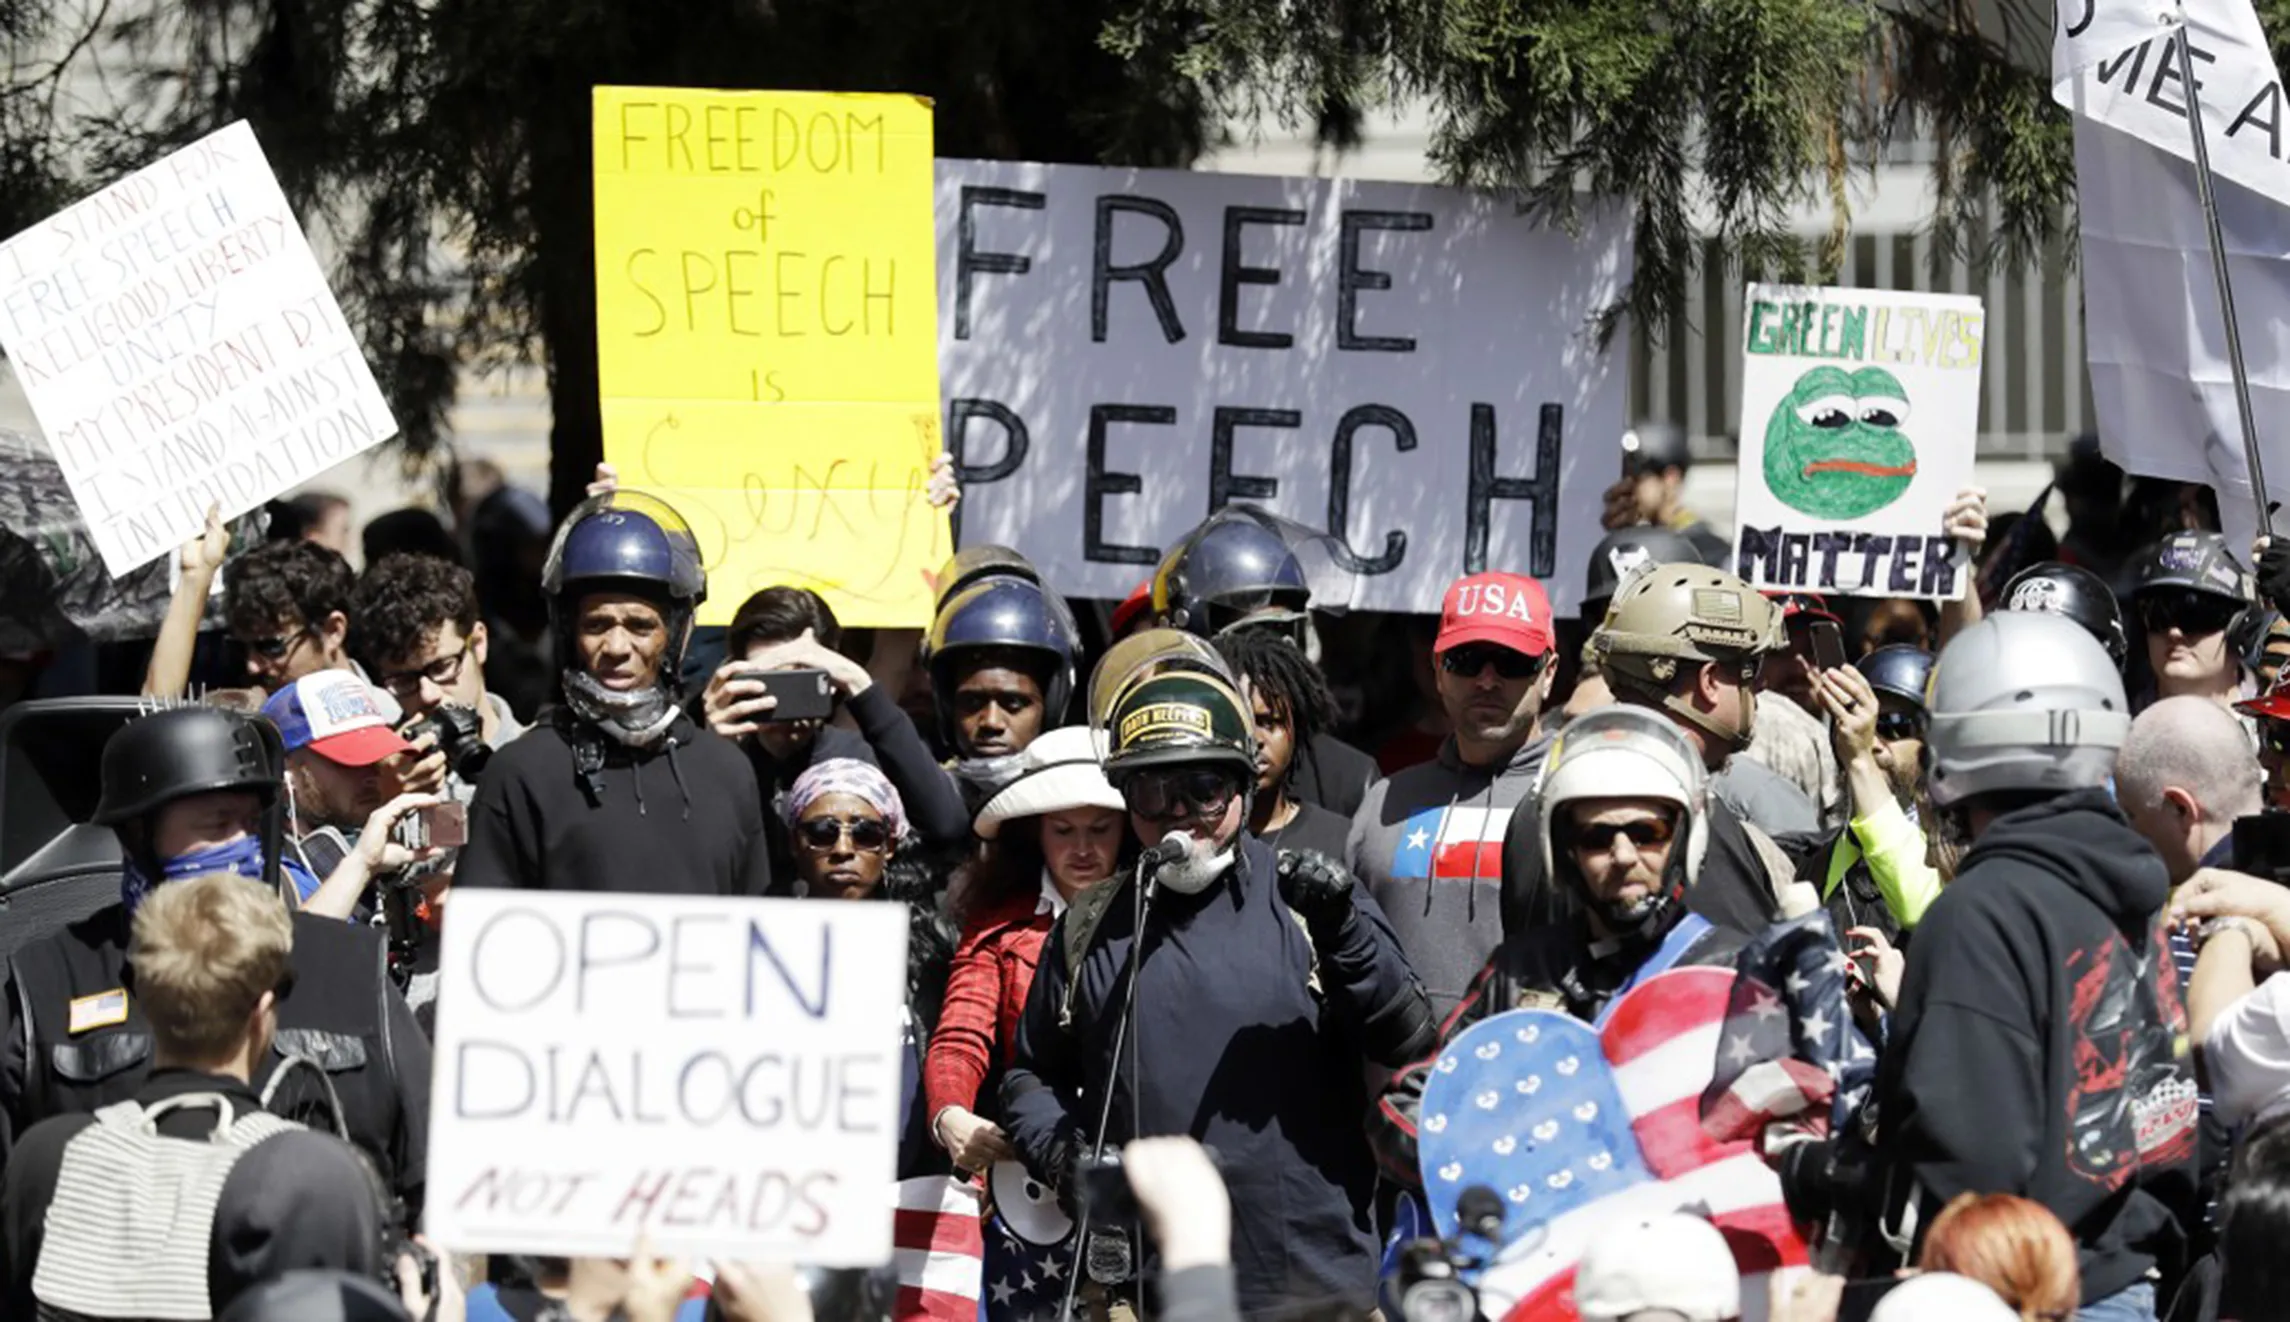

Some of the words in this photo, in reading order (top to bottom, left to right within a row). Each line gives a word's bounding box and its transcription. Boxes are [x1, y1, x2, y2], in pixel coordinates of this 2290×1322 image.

[621, 102, 885, 174] FREEDOM
[2224, 80, 2290, 165] A
[7, 236, 37, 284] I
[50, 176, 158, 257] STAND
[169, 136, 239, 191] FOR
[732, 189, 778, 243] of
[2, 259, 100, 336] FREE
[101, 186, 237, 285] SPEECH
[15, 276, 170, 387] RELIGIOUS
[174, 205, 286, 299] LIBERTY
[626, 248, 896, 338] SPEECH
[954, 185, 1434, 352] FREE
[102, 290, 219, 386] UNITY
[1748, 300, 1868, 361] GREEN
[1871, 306, 1980, 369] LIVES
[57, 405, 114, 471] MY
[111, 321, 277, 444] PRESIDENT
[79, 471, 123, 523] I
[119, 418, 226, 506] STAND
[942, 398, 1564, 579] PEECH
[1457, 583, 1533, 623] USA
[1738, 524, 1957, 596] MATTER
[469, 905, 836, 1024] OPEN
[453, 1038, 885, 1135] DIALOGUE
[452, 1165, 602, 1216] NOT
[610, 1166, 842, 1238] HEADS
